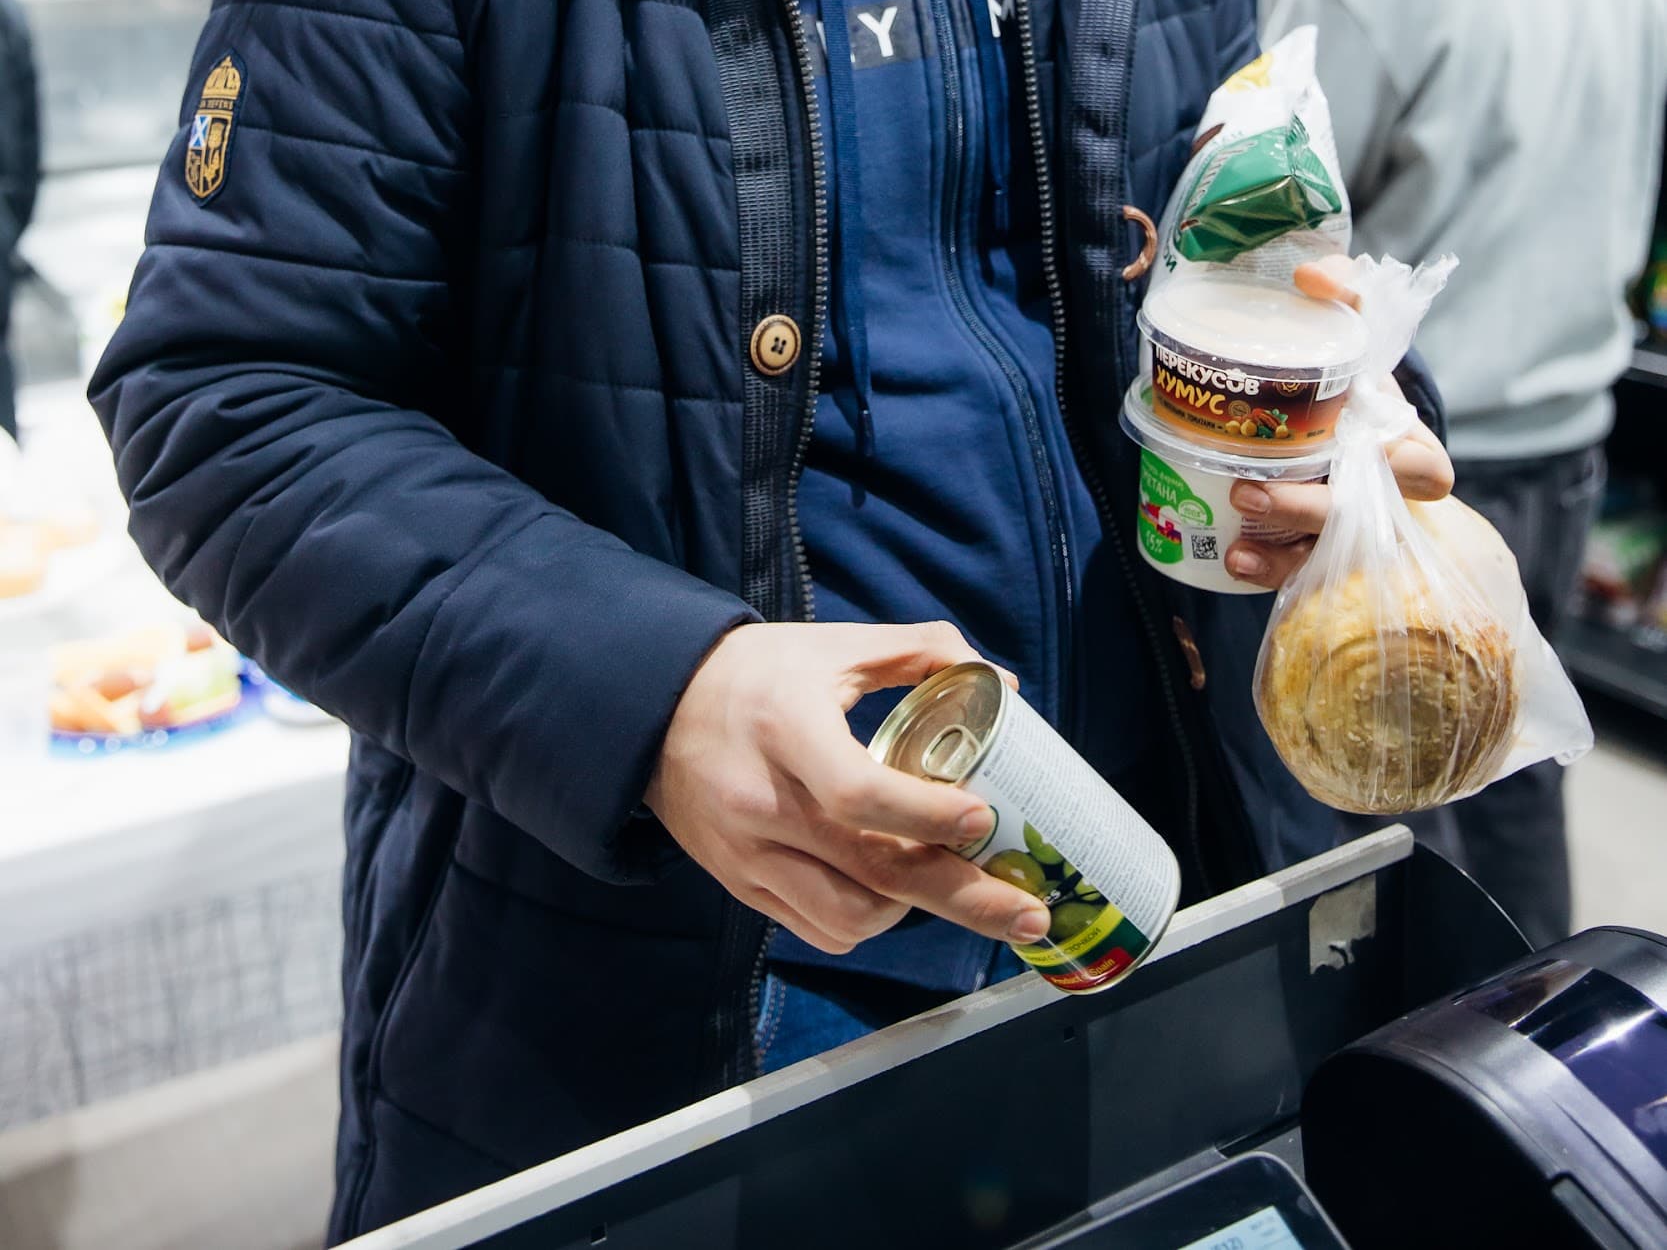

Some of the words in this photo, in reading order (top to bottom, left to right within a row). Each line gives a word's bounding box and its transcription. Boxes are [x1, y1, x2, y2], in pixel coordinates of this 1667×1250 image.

[1155, 344, 1260, 396] ПЕРЕКУСОВ
[1156, 364, 1226, 415] ХУМУС
[1088, 958, 1116, 978] Spain
